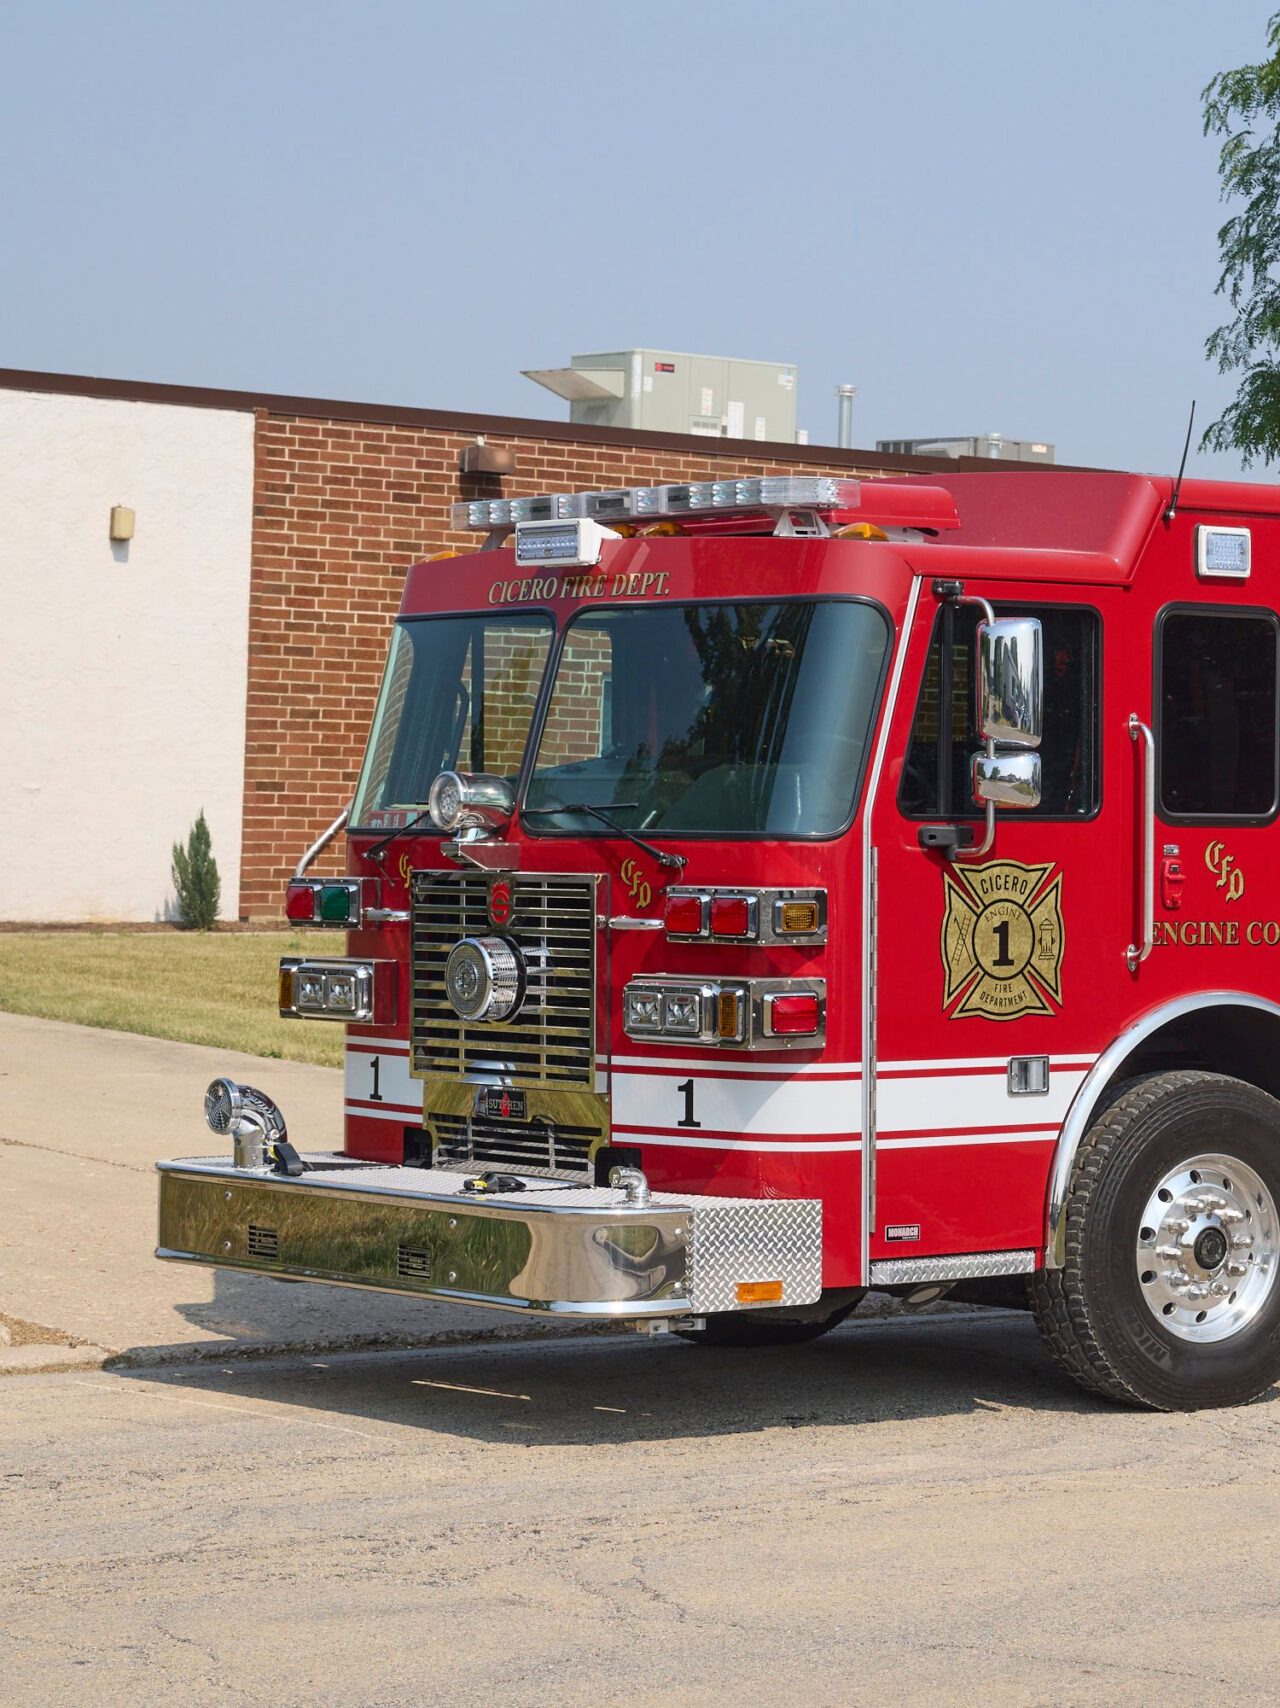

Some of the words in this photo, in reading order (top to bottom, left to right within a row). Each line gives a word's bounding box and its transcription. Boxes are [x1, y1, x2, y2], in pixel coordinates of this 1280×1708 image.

[488, 577, 557, 604] CICERO
[559, 574, 607, 598] FIRE
[611, 572, 670, 597] DEPT.
[980, 874, 1029, 896] CICERO
[984, 906, 1024, 923] ENGINE
[992, 920, 1015, 967] 1
[1152, 921, 1240, 946] ENGINE
[979, 991, 1028, 1008] DEPARTMENT
[994, 983, 1013, 993] FIRE
[370, 1055, 383, 1101] 1
[676, 1078, 702, 1128] 1
